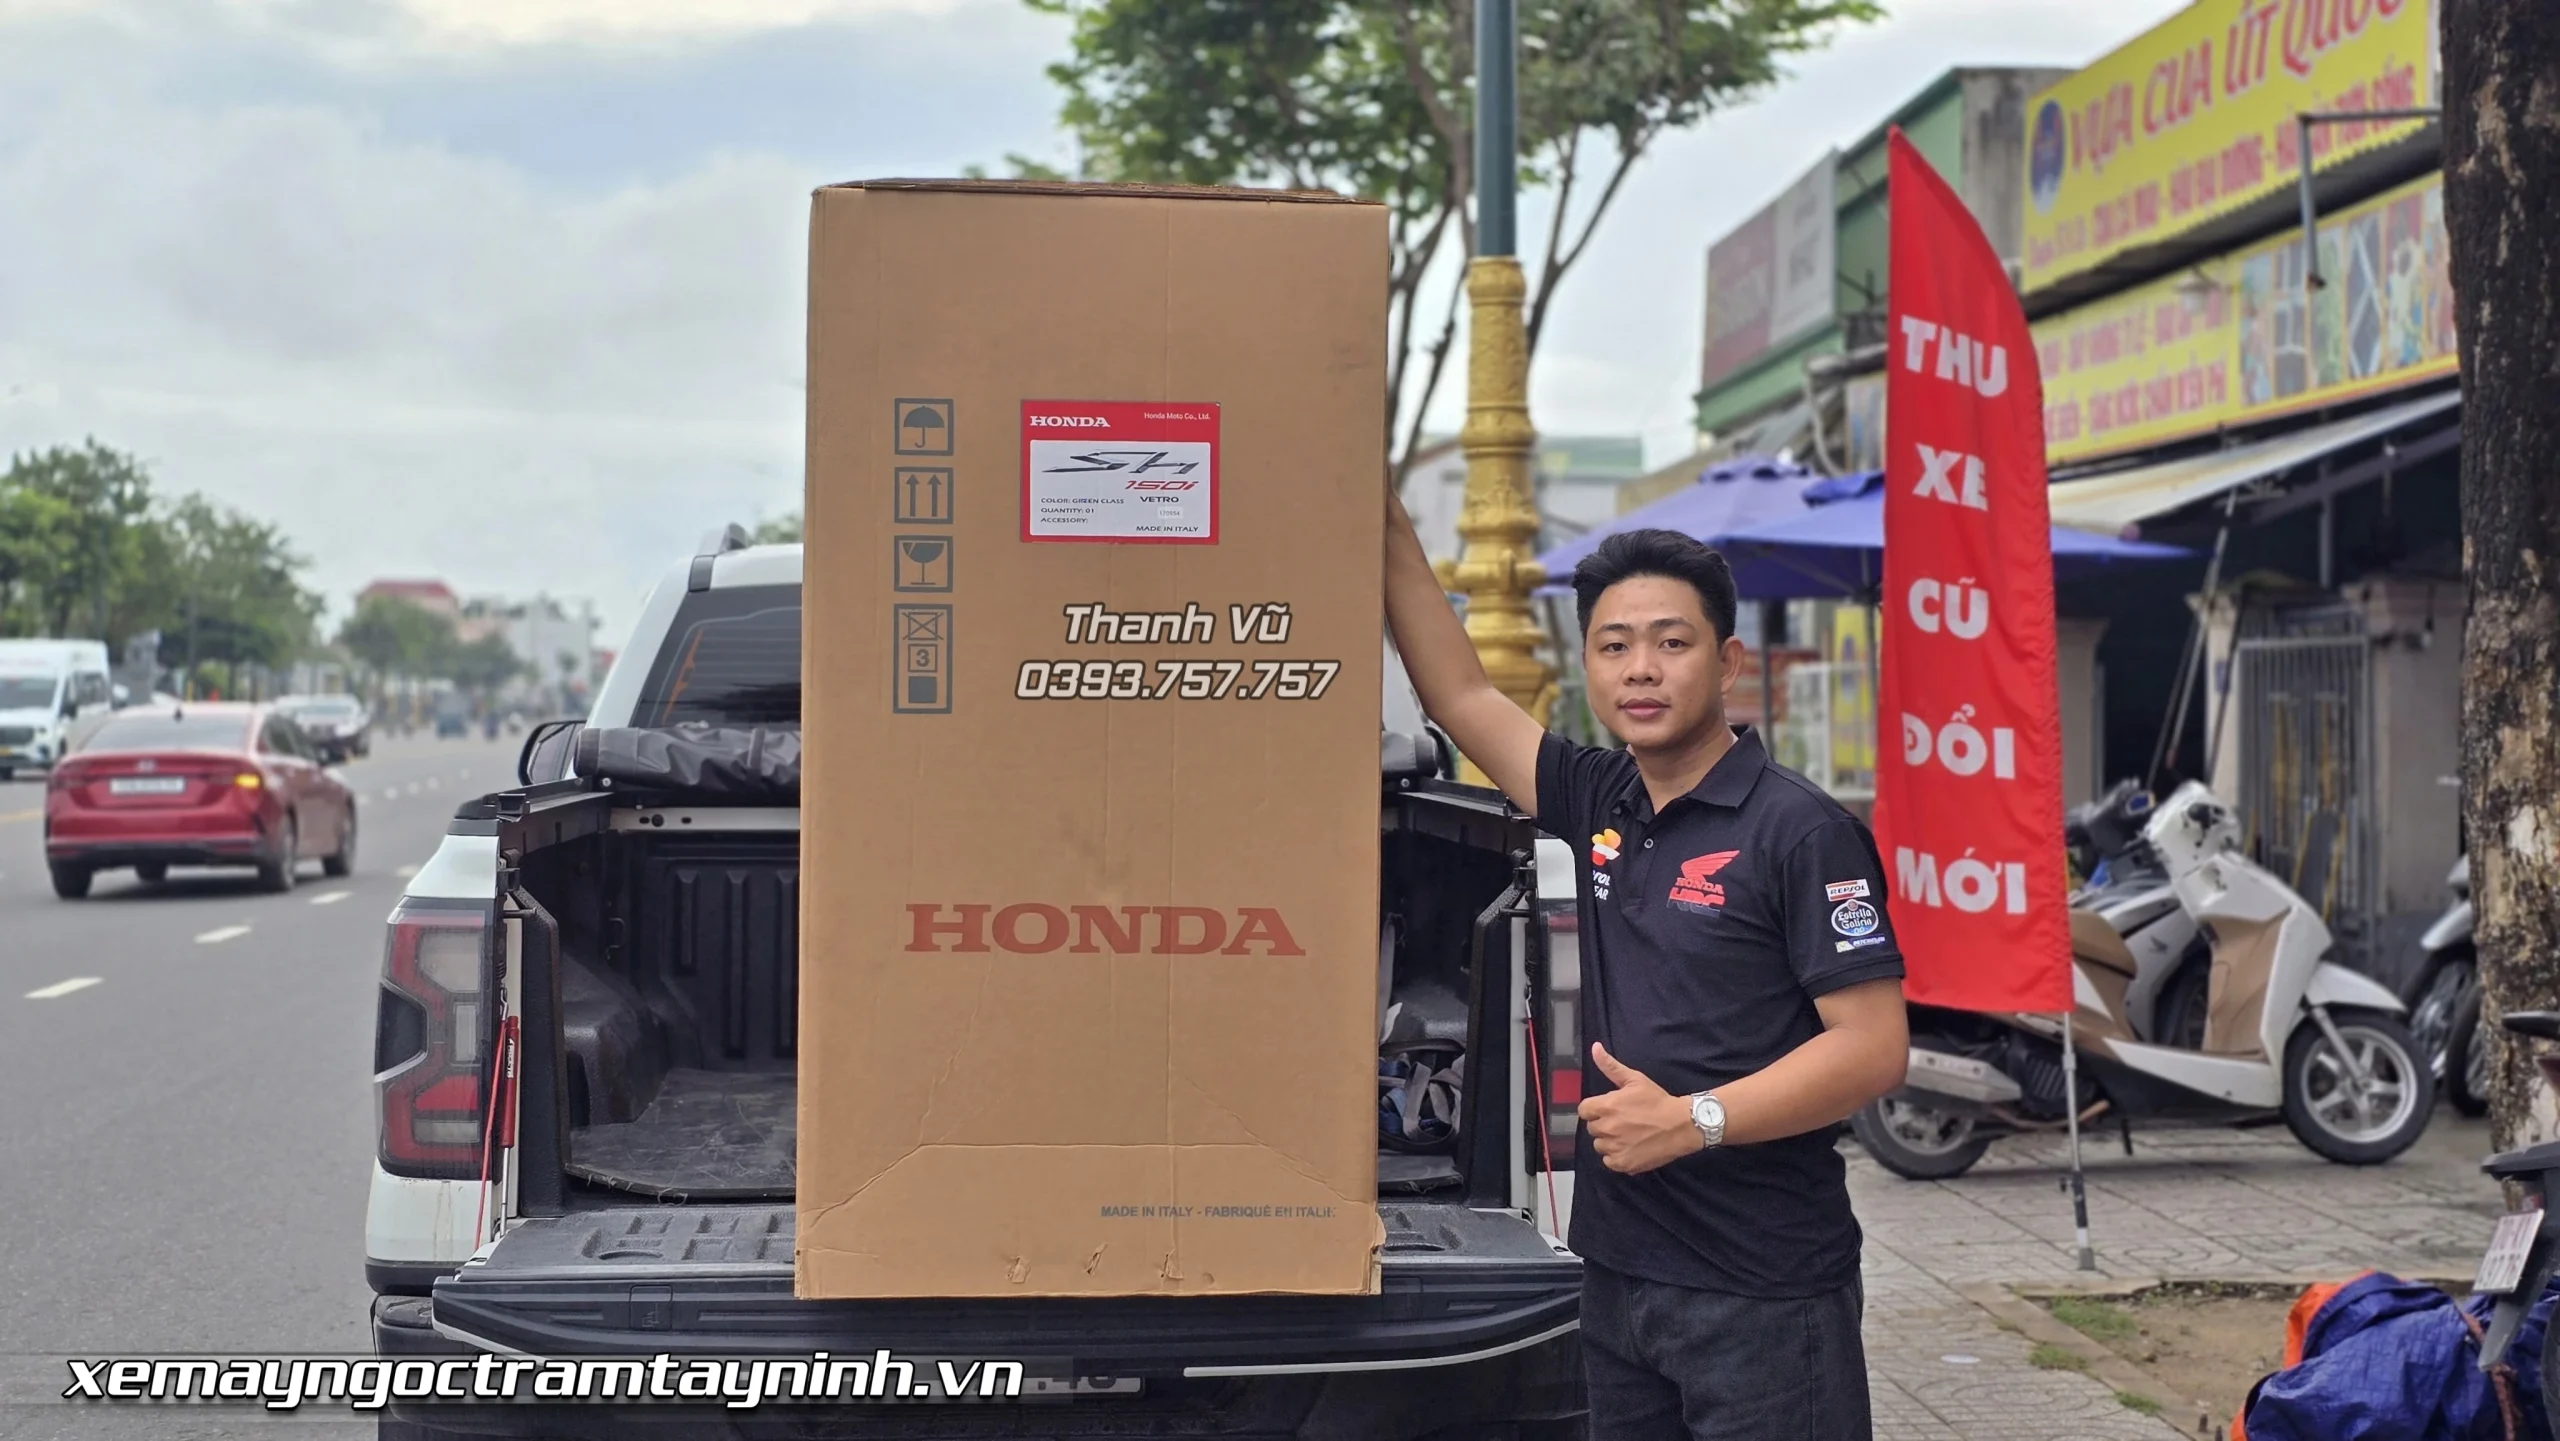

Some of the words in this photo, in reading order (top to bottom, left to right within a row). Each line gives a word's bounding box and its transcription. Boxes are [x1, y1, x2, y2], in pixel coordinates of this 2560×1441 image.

[2142, 37, 2213, 135] CUA
[1901, 313, 2008, 397] THU
[1029, 415, 1111, 428] HONDA
[1144, 412, 1166, 420] Honda
[1166, 412, 1183, 420] Moto
[1125, 480, 1199, 490] 150i
[1912, 442, 1989, 512] XE
[1908, 576, 1989, 640] CŨ
[915, 648, 930, 668] 3
[1674, 876, 1725, 896] HONDA
[1830, 884, 1866, 895] REPSOL
[1895, 846, 2027, 915] MỚI
[1837, 908, 1872, 921] Estrella
[1841, 918, 1873, 930] Galicia
[904, 902, 1306, 956] HONDA
[1101, 1206, 1139, 1217] MADE
[1142, 1206, 1155, 1217] IN
[1158, 1206, 1194, 1217] ITALY
[1204, 1204, 1272, 1218] FABRIQUÉ
